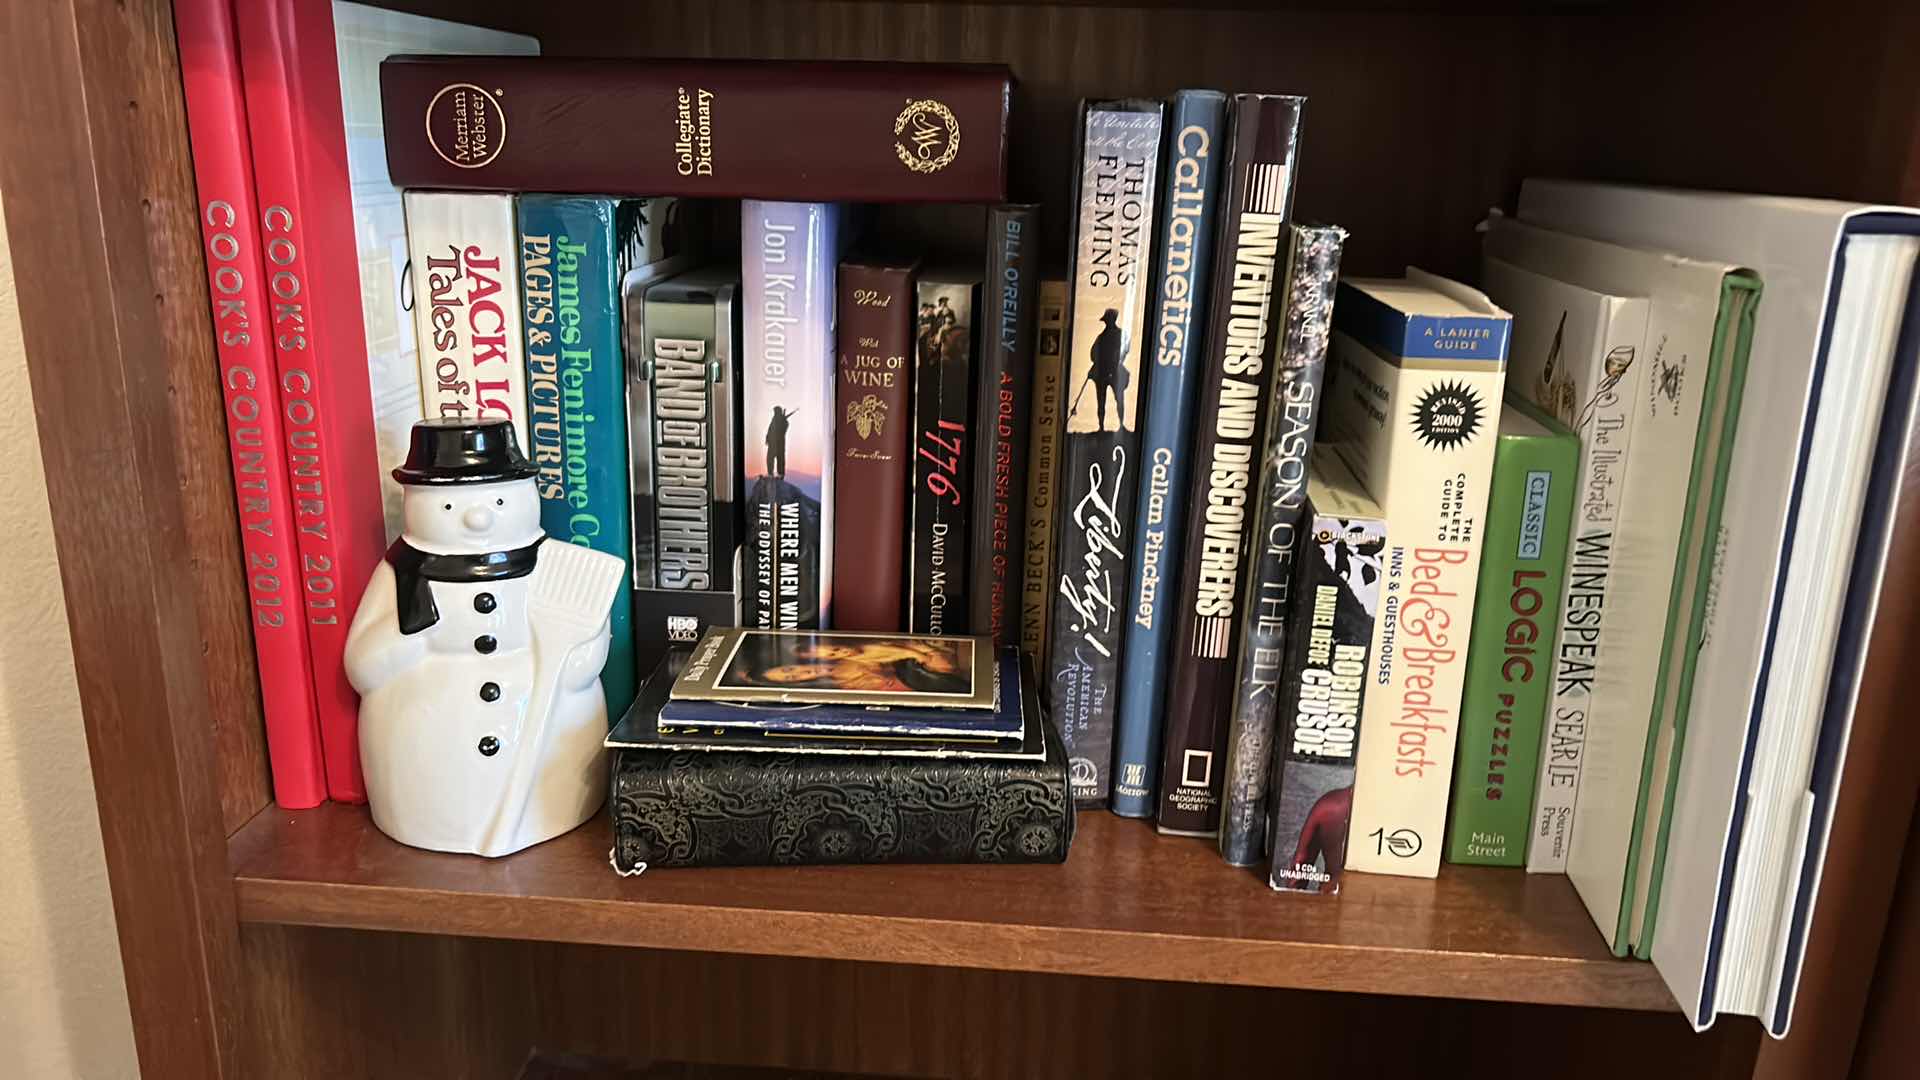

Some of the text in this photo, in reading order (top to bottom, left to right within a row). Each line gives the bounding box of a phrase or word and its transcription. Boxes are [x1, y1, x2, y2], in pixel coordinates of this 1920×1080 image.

[453, 91, 470, 161] Merriam
[471, 93, 488, 158] Webster
[695, 88, 714, 177] Dictionary
[1090, 154, 1118, 289] FLEMING
[1117, 157, 1145, 287] THOMAS
[1157, 125, 1210, 368] Callanetics
[427, 245, 463, 351] Tales
[463, 245, 508, 367] JACK
[556, 235, 587, 345] James
[764, 219, 798, 388] Jon Krakauer
[1001, 219, 1022, 352] BILL O'REILLY
[521, 232, 565, 500] PAGES & PICTURES
[855, 355, 881, 369] JUG
[886, 356, 904, 369] OF
[1424, 327, 1490, 339] A LANIER
[1433, 340, 1479, 351] GUIDE
[436, 357, 470, 396] of
[654, 337, 706, 420] BAND
[844, 369, 895, 388] WINE
[1000, 371, 1013, 385] A
[1040, 375, 1056, 426] Sense
[206, 200, 285, 628] COOK'S COUNTRY 2012
[264, 205, 338, 625] COOK'S COUNTRY 2011
[561, 348, 595, 509] Fenimore
[998, 389, 1014, 438] BOLD
[1196, 212, 1281, 618] INVENTORS AND DISCOVERERS
[1271, 381, 1315, 509] SEASON
[1431, 414, 1463, 426] 2000
[1595, 413, 1624, 444] The
[919, 419, 966, 505] 1776
[994, 441, 1011, 499] FRESH
[1034, 434, 1051, 508] Common
[1584, 449, 1622, 522] Illustrated
[657, 446, 709, 590] BROTHERS
[759, 503, 771, 525] THE
[993, 501, 1008, 550] PIECE
[1135, 447, 1172, 630] Callan Pinckney
[1438, 479, 1452, 541] GUIDE TO
[1450, 472, 1466, 542] COMPLETE
[1462, 518, 1473, 542] THE
[1522, 477, 1545, 553] CLASSIC
[758, 531, 771, 586] ODYSSEY
[780, 502, 800, 630] WHERE MEN WIN
[932, 523, 948, 566] DAVID
[992, 555, 1007, 578] OF
[1026, 518, 1046, 593] BECK'S
[1059, 445, 1126, 657] Liberty!
[1267, 523, 1295, 566] OF
[667, 616, 698, 630] HBO
[758, 590, 771, 606] OF
[1257, 575, 1289, 637] THE
[1307, 585, 1338, 665] DANIEL DEFOE
[1379, 546, 1404, 685] INNS & GUESTHOUSES
[1502, 570, 1546, 683] LOGIC
[1557, 531, 1612, 696] WINESPEAK
[668, 631, 698, 640] VIDEO
[1058, 664, 1079, 742] REVOLUTION
[1076, 648, 1093, 730] AMERICAN
[1093, 684, 1107, 714] THE
[1249, 647, 1280, 700] ELK
[1322, 644, 1366, 757] ROBINSON
[1293, 668, 1332, 756] CRUSOE
[1485, 693, 1514, 800] PUZZLES
[1169, 794, 1217, 804] GEOGRAPHIC
[1176, 787, 1213, 797] NATIONAL
[1176, 803, 1208, 811] SOCIETY
[1541, 807, 1556, 837] Press
[1467, 844, 1507, 857] Street
[1471, 832, 1505, 845] Main
[1553, 806, 1571, 858] Souvenir
[1280, 869, 1330, 882] UNABRIDGED
